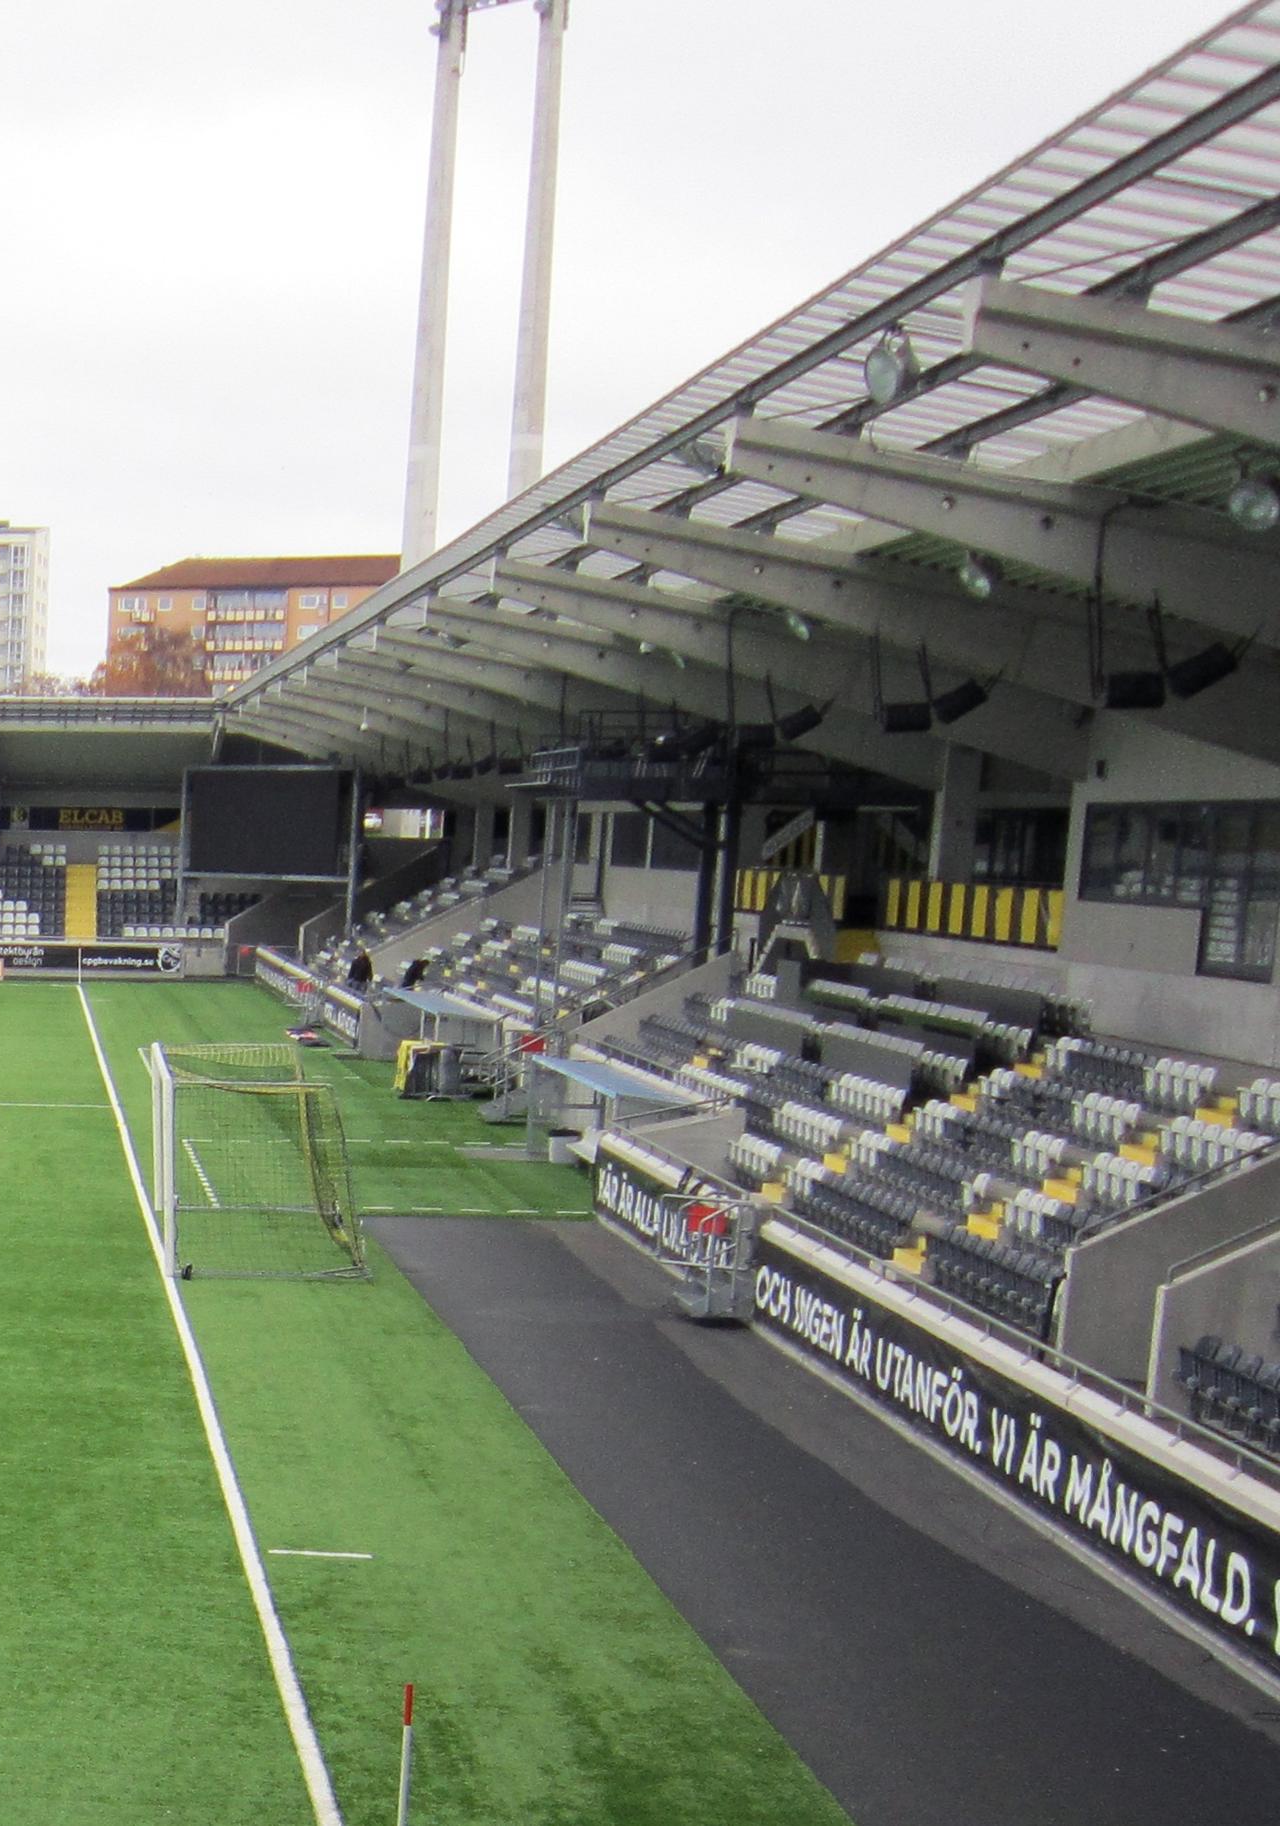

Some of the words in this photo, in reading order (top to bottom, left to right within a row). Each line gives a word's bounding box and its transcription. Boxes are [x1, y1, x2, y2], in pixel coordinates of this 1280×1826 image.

[59, 808, 124, 823] ELCAB
[755, 1265, 791, 1325] OCH
[792, 1286, 845, 1360] INGEN
[845, 1308, 872, 1381] ÄR
[875, 1337, 982, 1455] UTANFÖR.
[992, 1407, 1015, 1475] VI
[1018, 1412, 1061, 1505] ÄR
[1064, 1455, 1256, 1636] MÅNGFALD.
